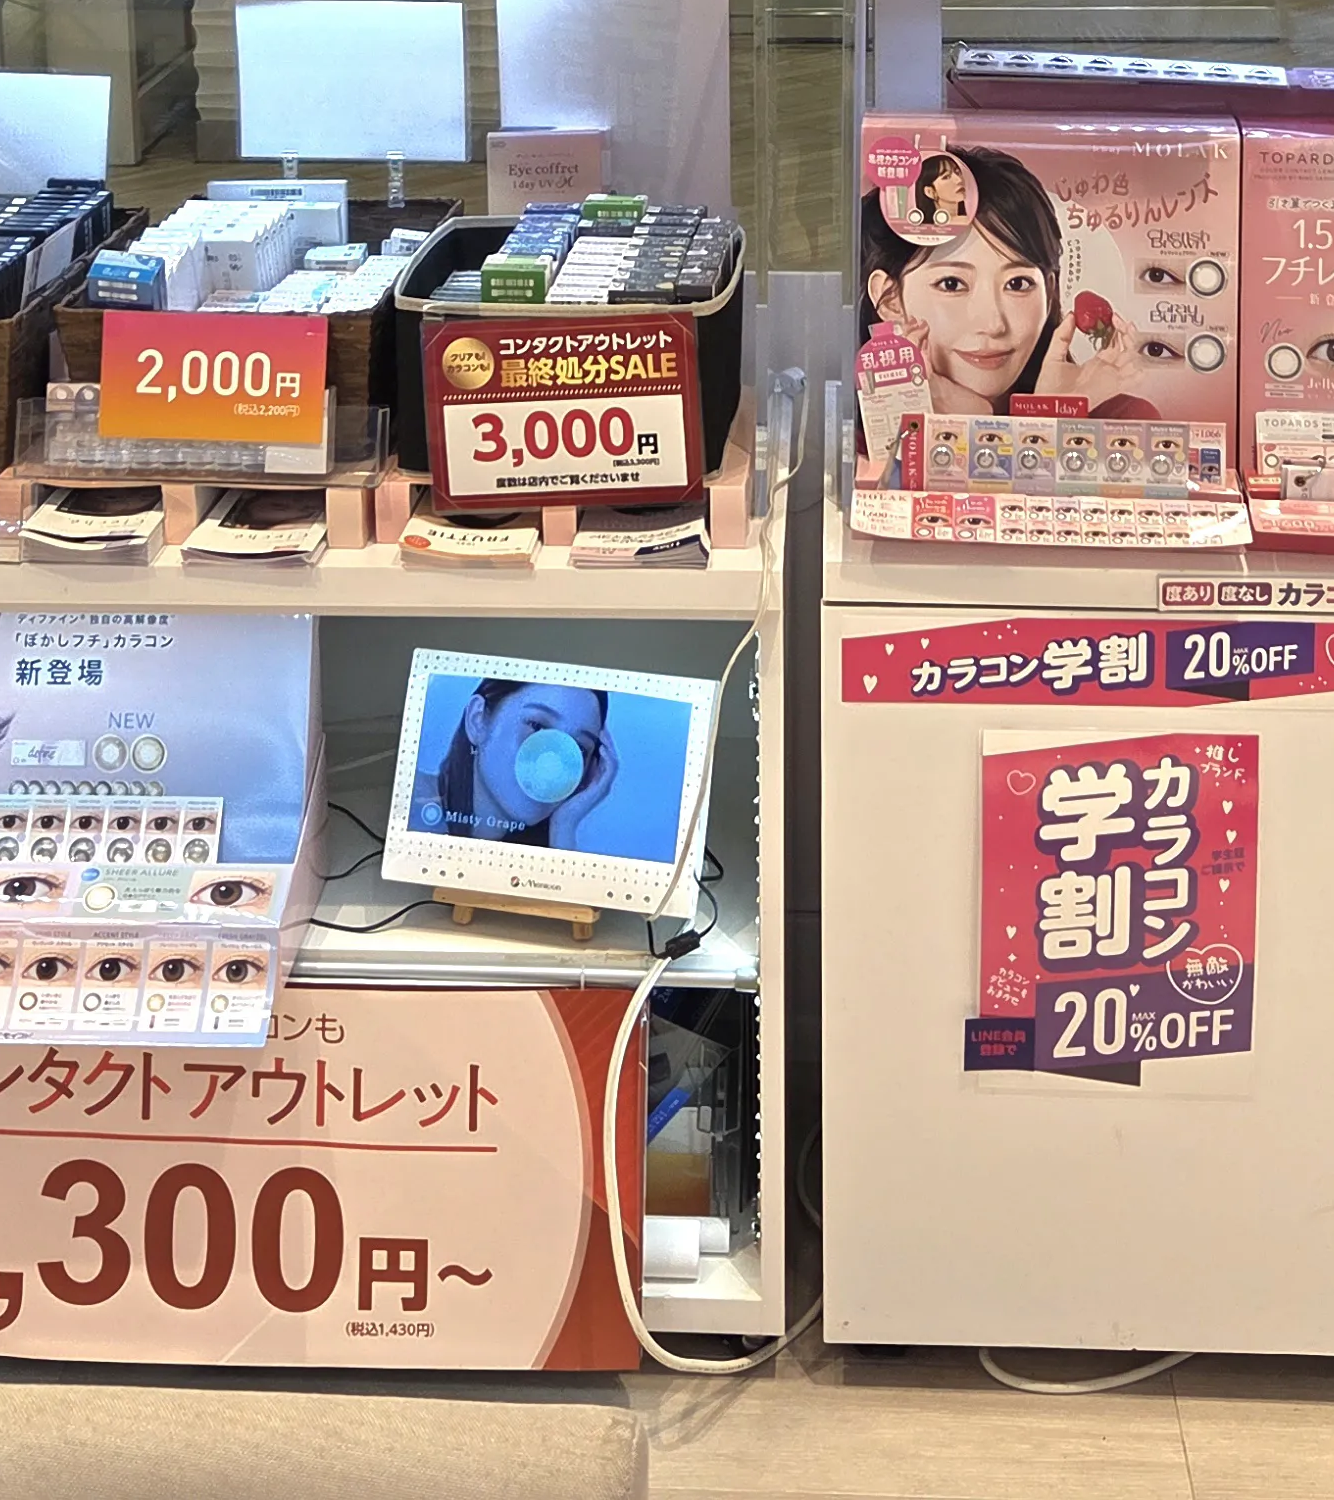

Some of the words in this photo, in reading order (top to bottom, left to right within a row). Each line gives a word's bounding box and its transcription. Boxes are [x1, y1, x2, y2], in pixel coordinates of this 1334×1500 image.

[1131, 141, 1229, 160] MOLAK
[509, 164, 532, 177] Eye
[536, 162, 579, 174] coffret
[1053, 173, 1130, 202] じゅわ色
[1065, 173, 1219, 231] ちゅるりんレンズ
[499, 331, 673, 355] コンタクトアウトレット
[449, 352, 485, 361] クリアも!
[860, 347, 915, 369] 乱視用
[136, 350, 301, 403] 2,000円
[447, 363, 490, 373] カラコンも!
[500, 353, 678, 387] 最終処分SALE
[232, 403, 301, 417] (税込2,200円)
[1014, 401, 1050, 410] MOLAK
[1055, 400, 1079, 415] 1day
[1264, 418, 1319, 429] TOPARDS
[472, 406, 658, 467] 3,000円
[496, 472, 640, 488] 度数は店内でご覧くださいませ
[1162, 584, 1212, 605] 度あり
[1220, 584, 1270, 605] 度なし
[15, 633, 175, 650] 「ぼかしフチ」カラコン
[15, 659, 104, 686] 新登場
[911, 631, 1149, 693] カラコン学割
[1182, 632, 1299, 681] 20%OFF
[107, 712, 155, 729] NEW
[446, 810, 481, 826] Misty
[487, 814, 526, 832] Grape
[1037, 762, 1137, 962] 学割
[1140, 756, 1193, 961] カラコン
[105, 869, 139, 877] SHEER
[142, 869, 179, 877] ALLURE
[1184, 956, 1230, 979] 無敵
[1052, 988, 1235, 1058] 20%OFF
[970, 1028, 1027, 1043] LINE会員
[345, 1320, 435, 1340] (税込1,430円)
